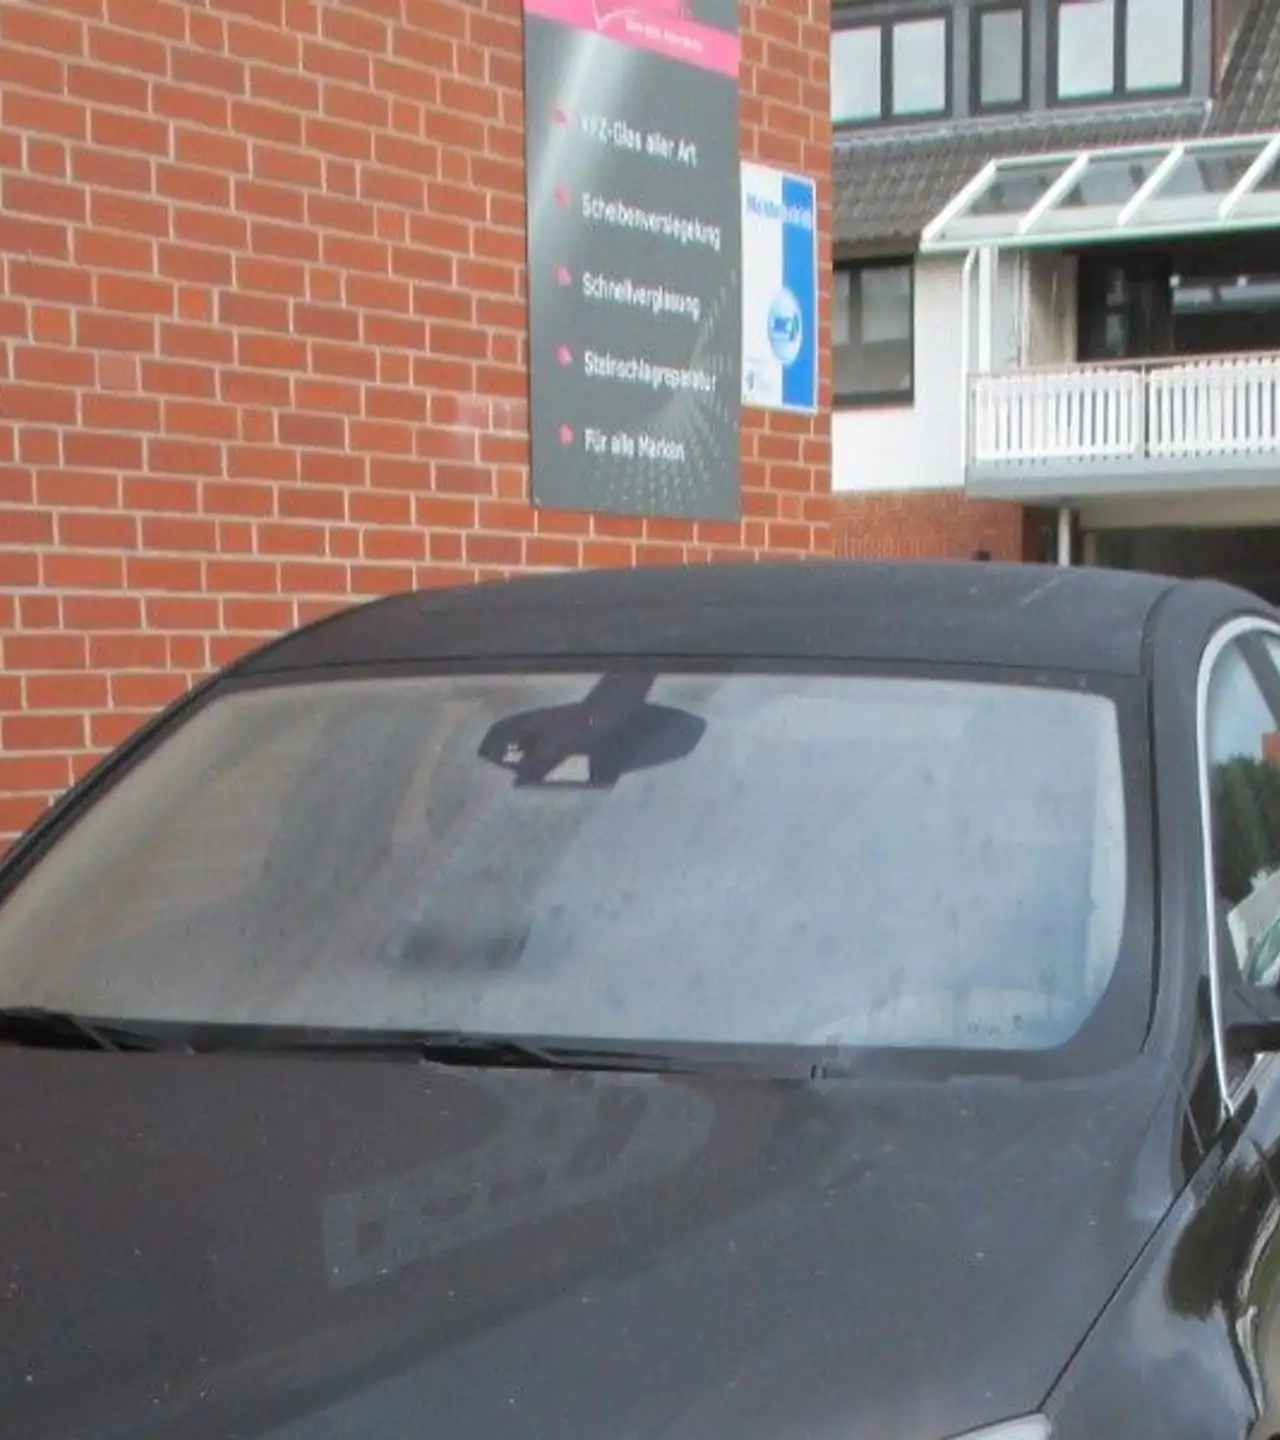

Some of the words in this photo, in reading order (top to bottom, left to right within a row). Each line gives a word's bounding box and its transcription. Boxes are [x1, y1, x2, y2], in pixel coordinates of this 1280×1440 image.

[677, 138, 698, 167] Art
[584, 428, 607, 453] Für
[611, 432, 635, 458] alle
